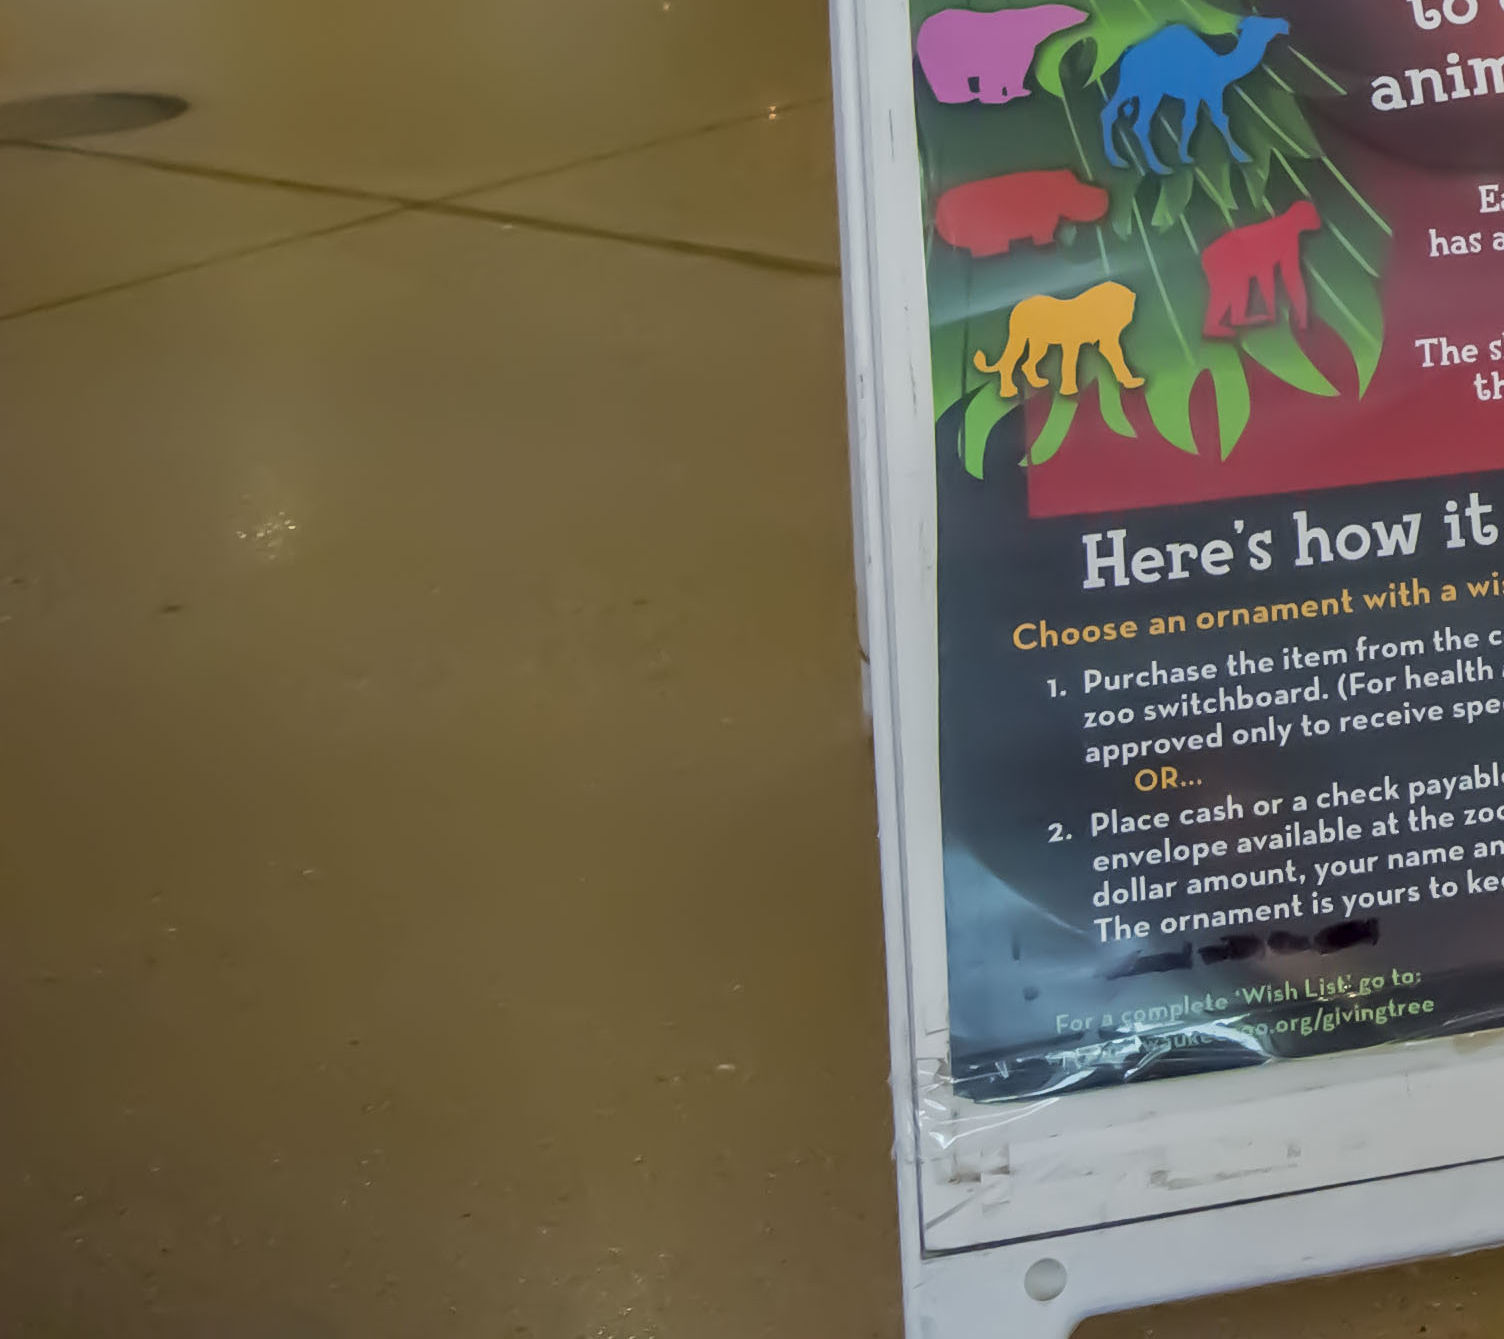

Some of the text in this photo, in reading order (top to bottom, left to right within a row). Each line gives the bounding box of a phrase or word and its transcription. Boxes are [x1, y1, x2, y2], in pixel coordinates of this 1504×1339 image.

[1428, 228, 1482, 257] has
[1414, 336, 1479, 368] The
[1292, 510, 1422, 567] how
[1443, 492, 1499, 549] it
[1012, 619, 1138, 650] Choose
[1148, 615, 1186, 636] an
[1196, 588, 1354, 630] ornament
[1362, 577, 1431, 610] with
[1440, 584, 1457, 602] a
[1046, 678, 1067, 698] 1.
[1084, 660, 1218, 694] Purchase
[1226, 650, 1274, 677] the
[1282, 646, 1348, 670] item
[1355, 635, 1425, 662] from
[1432, 626, 1480, 652] the
[1083, 707, 1135, 729] zoo
[1143, 675, 1329, 721] switchboard.
[1337, 671, 1397, 701] (For
[1404, 656, 1494, 690] health
[1085, 722, 1223, 768] approved
[1232, 715, 1293, 747] only
[1300, 714, 1331, 737] to
[1339, 701, 1444, 732] receive
[1047, 822, 1073, 843] 2.
[1091, 808, 1170, 837] Place
[1179, 794, 1244, 825] cash
[1253, 797, 1284, 816] or
[1292, 795, 1308, 812] a
[1316, 775, 1400, 809] check
[1092, 837, 1228, 872] envelope
[1236, 815, 1363, 854] available
[1371, 811, 1400, 837] at
[1407, 805, 1455, 832] the
[1092, 875, 1178, 907] dollar
[1186, 859, 1306, 895] amount,
[1313, 855, 1379, 886] your
[1387, 845, 1465, 870] name
[1093, 914, 1151, 943] The
[1160, 893, 1304, 934] ornament
[1311, 890, 1334, 915] is
[1341, 886, 1421, 918] yours
[1428, 876, 1459, 899] to
[1055, 1013, 1093, 1035] For
[1121, 994, 1229, 1026] complete
[1359, 975, 1386, 997] go
